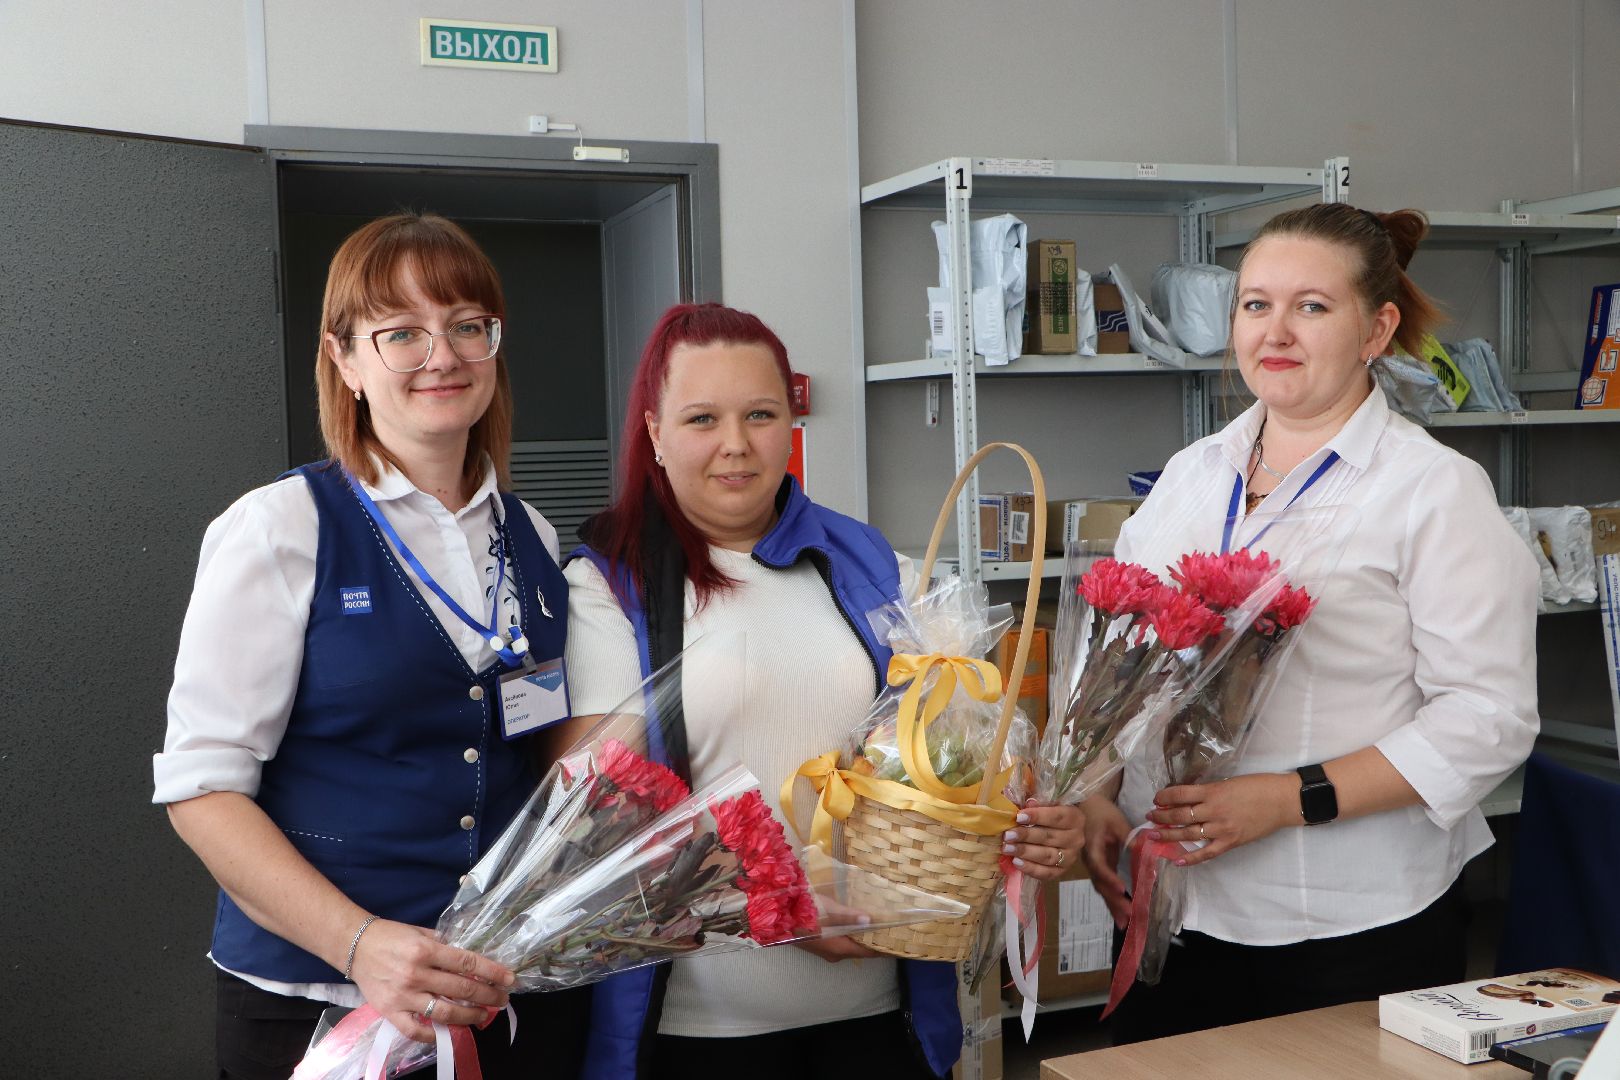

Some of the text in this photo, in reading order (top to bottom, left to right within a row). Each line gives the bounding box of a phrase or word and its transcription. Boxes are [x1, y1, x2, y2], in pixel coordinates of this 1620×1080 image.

[435, 30, 543, 64] ВЫХОД
[955, 168, 968, 189] 1
[1342, 167, 1350, 186] 2
[343, 592, 369, 600] ПОЧТА
[344, 600, 370, 609] РОССИИ
